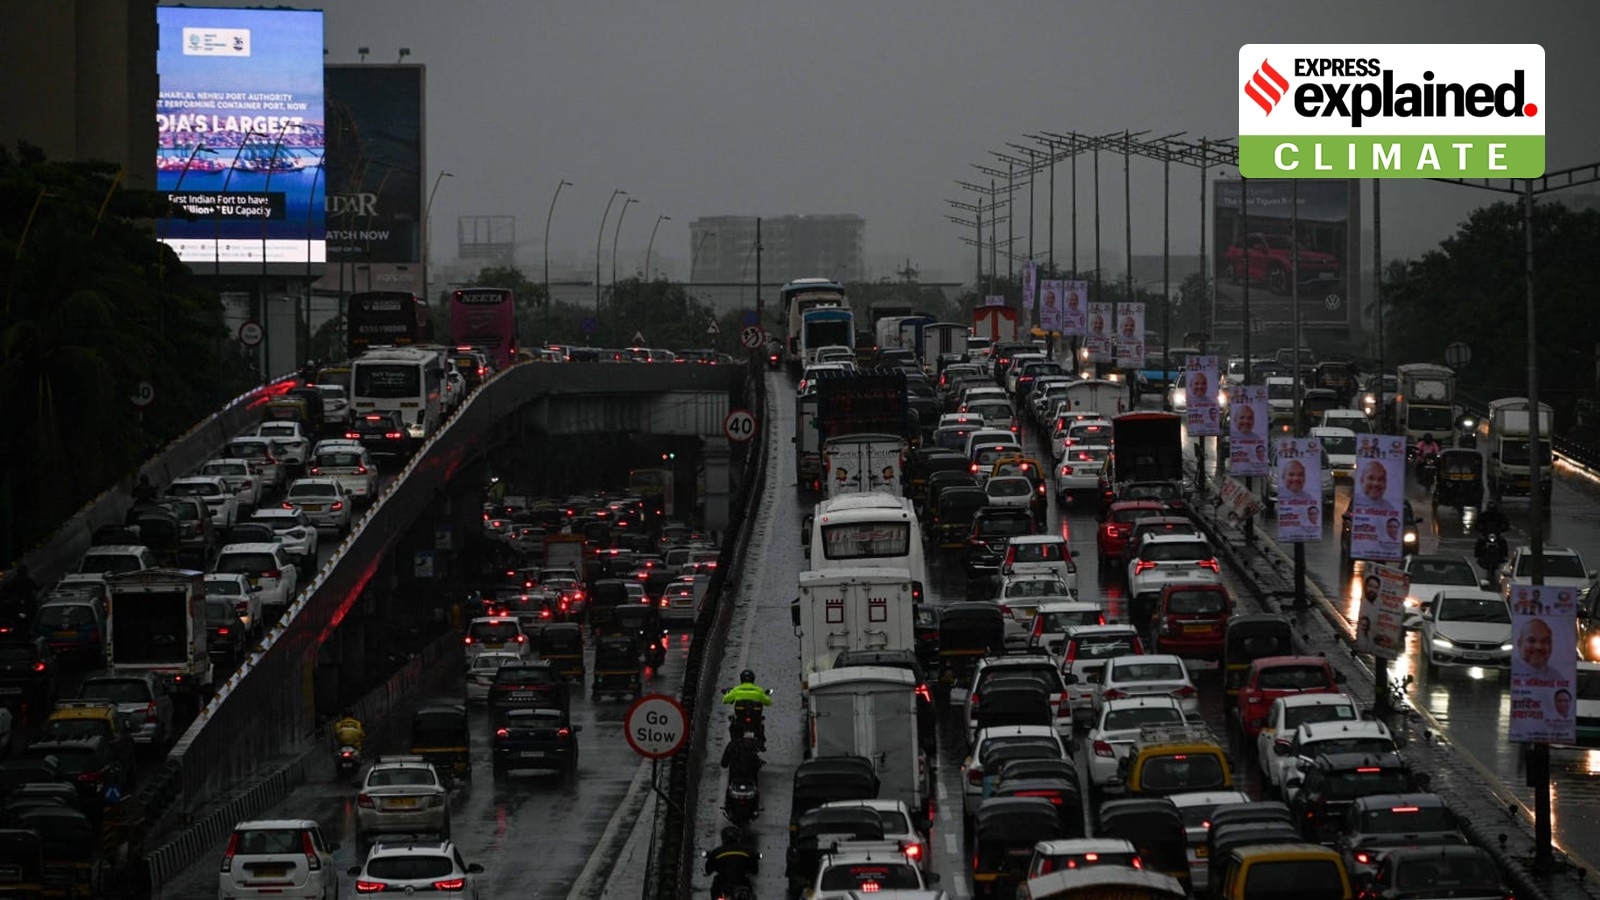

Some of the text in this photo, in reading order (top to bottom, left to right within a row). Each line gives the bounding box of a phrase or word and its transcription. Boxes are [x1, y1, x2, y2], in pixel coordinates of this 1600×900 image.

[197, 92, 225, 100] NEHRU
[226, 92, 246, 101] PORT
[248, 93, 293, 102] AUTHORITY
[165, 100, 215, 109] PERFORMING
[217, 101, 261, 110] CONTAINER
[287, 103, 307, 111] NOW
[212, 115, 304, 135] LARGEST
[189, 194, 216, 204] Indian
[237, 196, 247, 205] to
[359, 230, 390, 241] NOW
[728, 416, 754, 436] 40
[646, 710, 669, 726] Go
[636, 728, 676, 743] Slow
